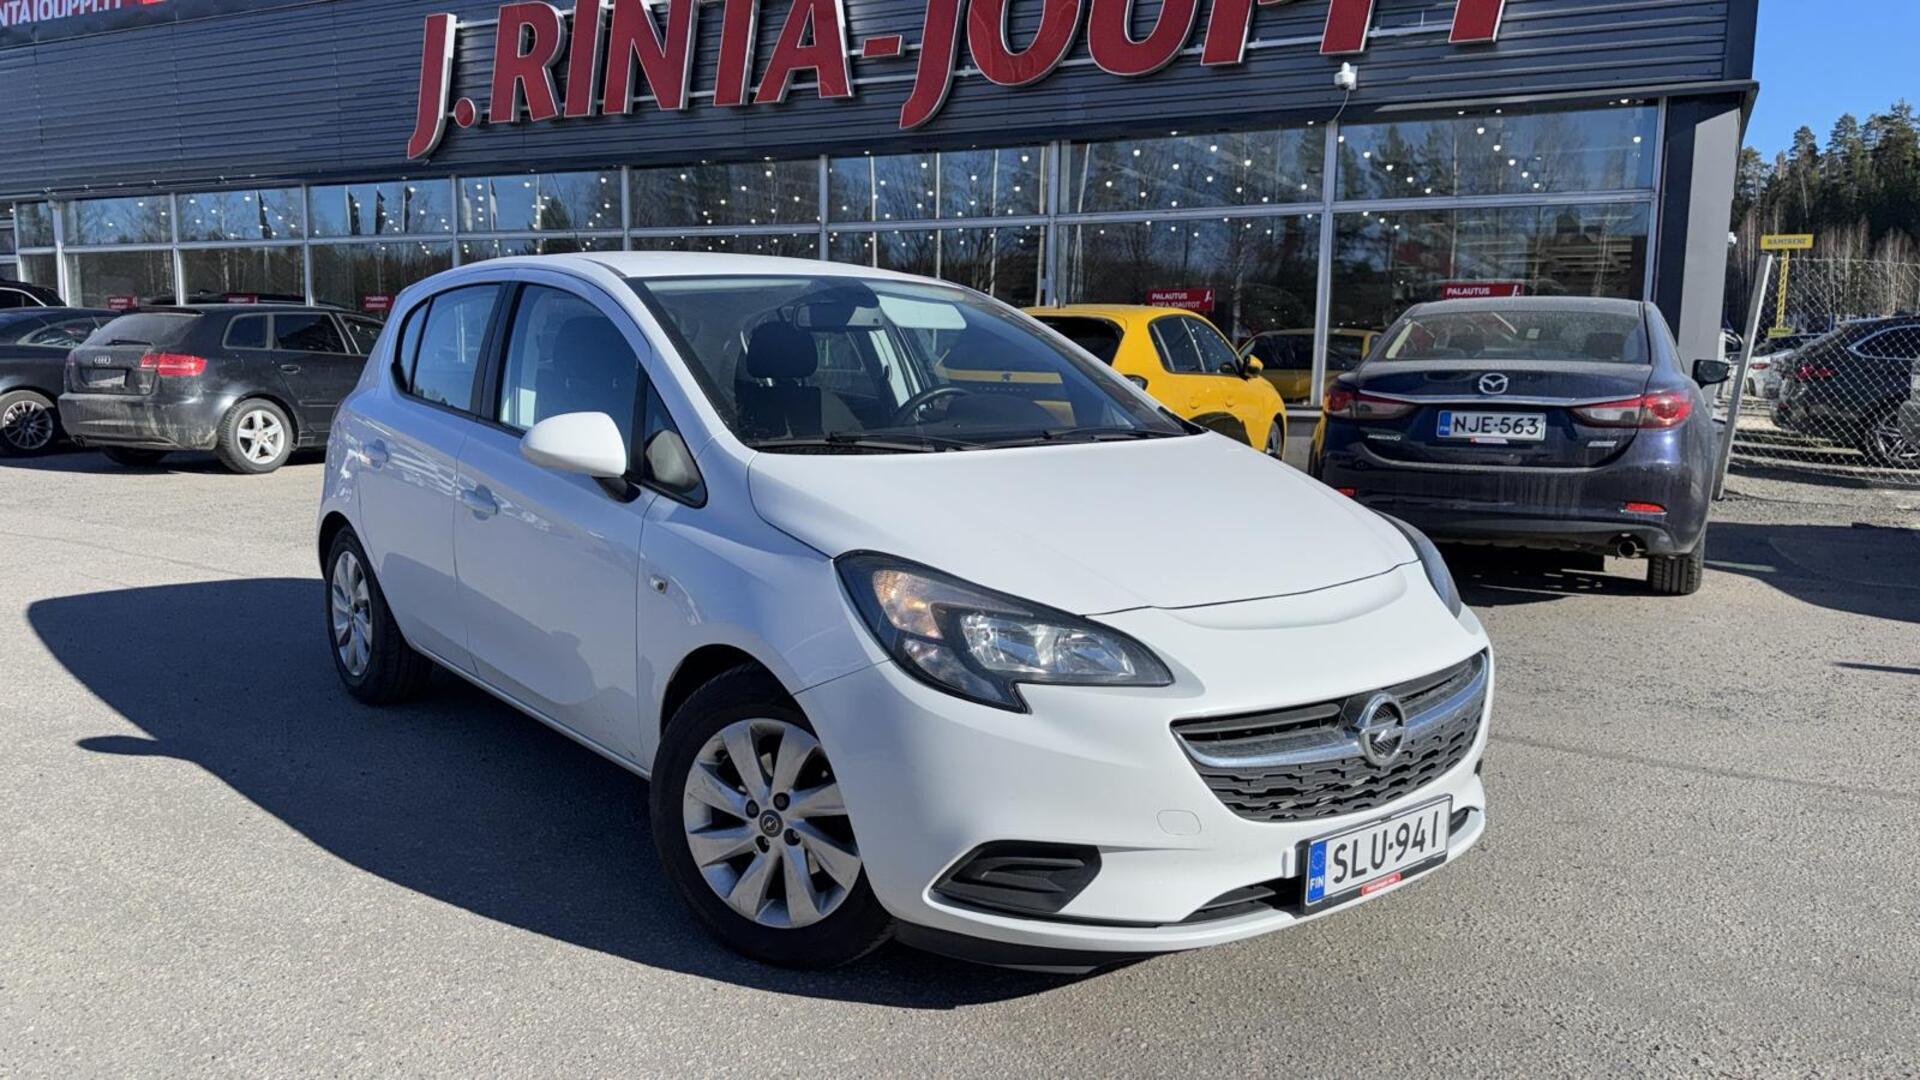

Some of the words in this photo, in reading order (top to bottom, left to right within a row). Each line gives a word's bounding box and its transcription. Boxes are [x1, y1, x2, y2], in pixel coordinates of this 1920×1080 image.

[407, 0, 1503, 160] J.RINTA-JOU
[1151, 292, 1188, 300] PALAUTUS
[1446, 286, 1491, 296] PALAUTUS
[1309, 875, 1325, 891] FIN
